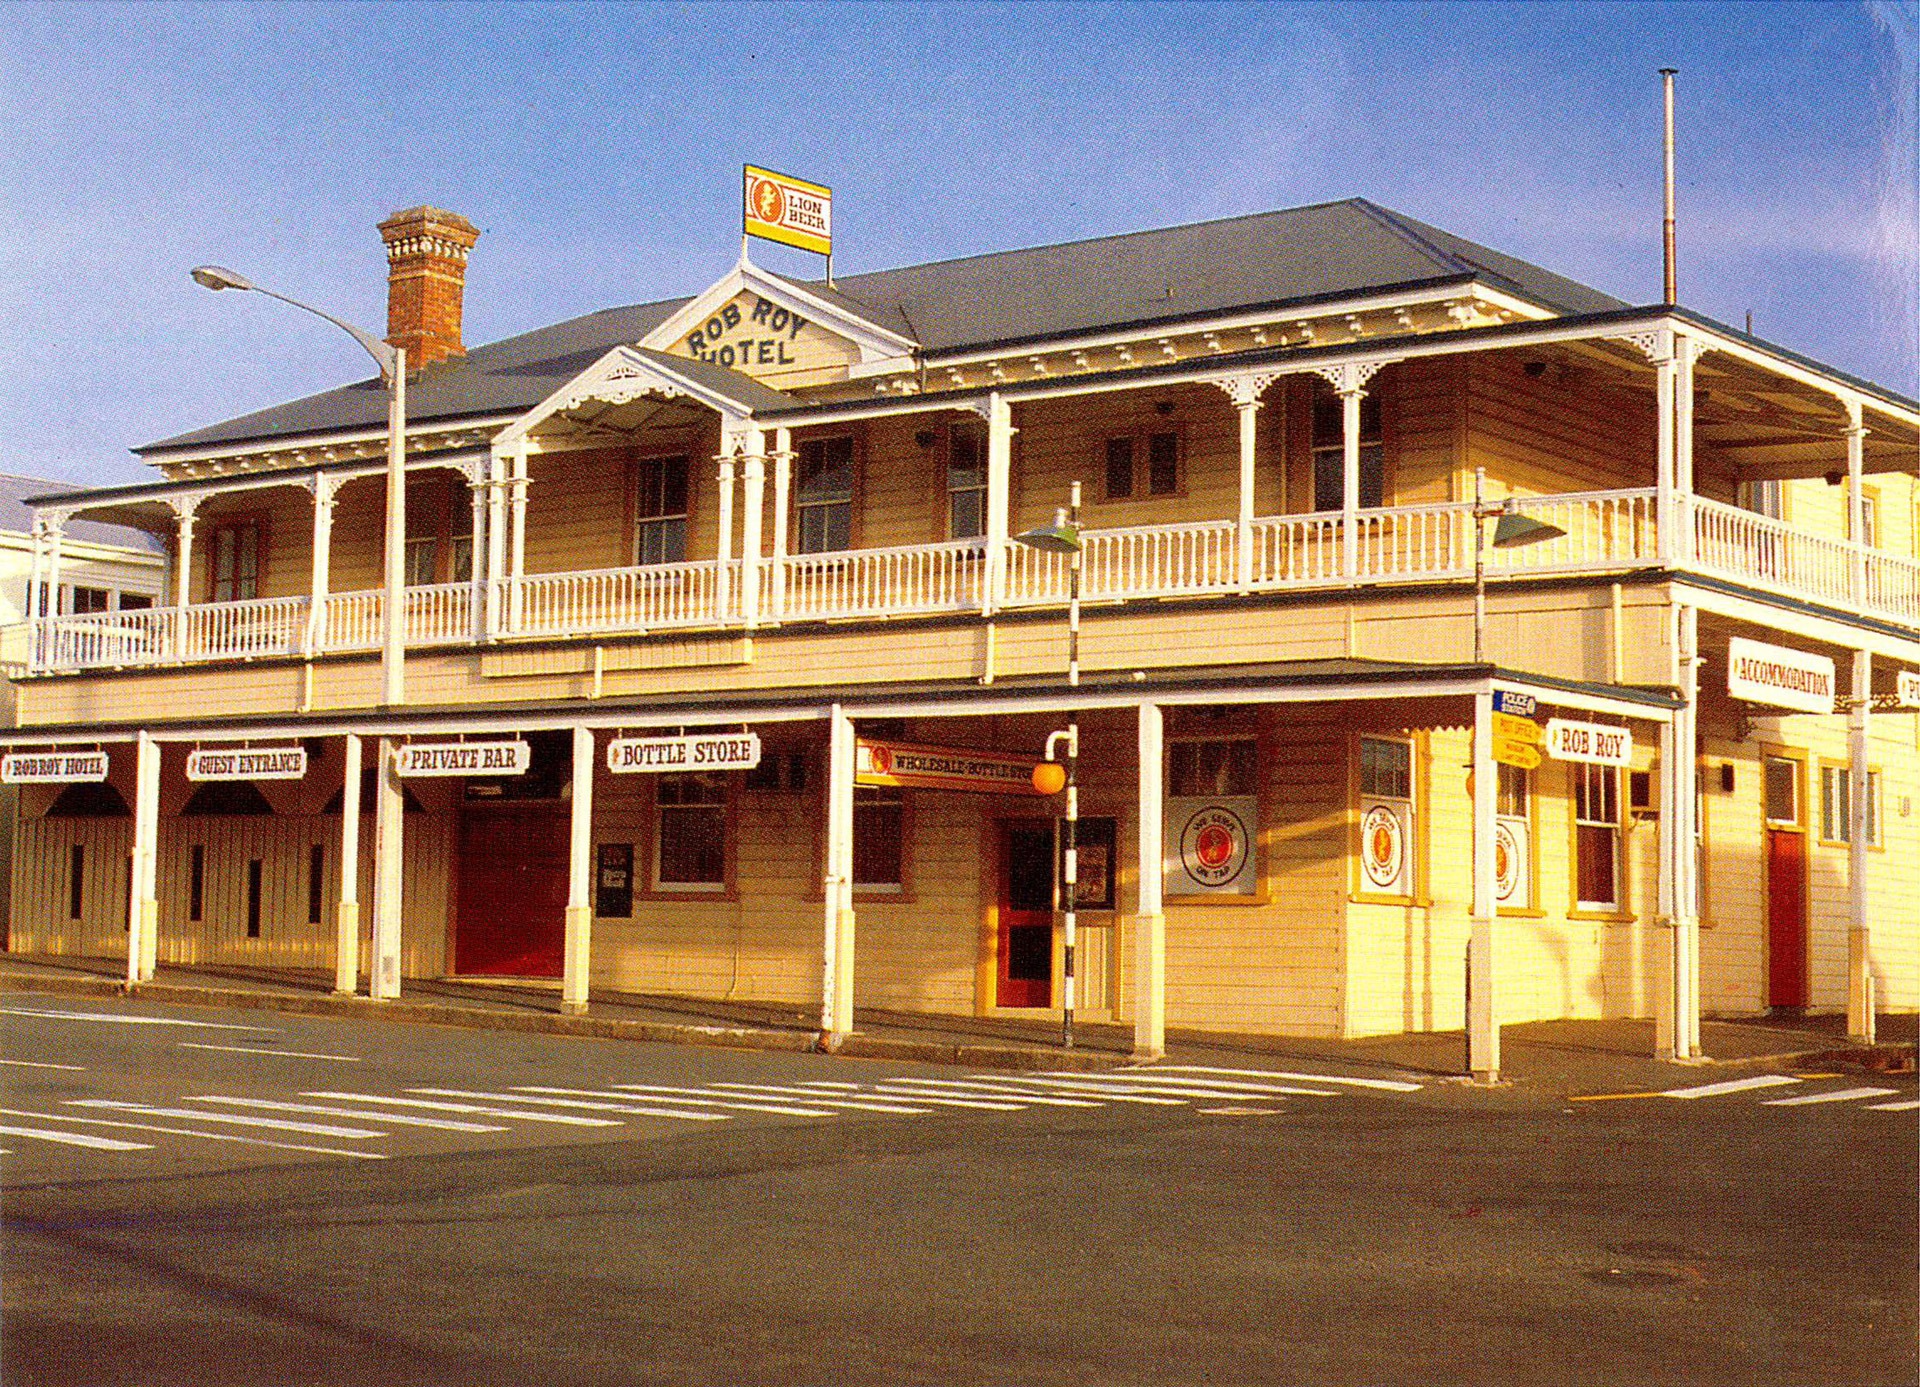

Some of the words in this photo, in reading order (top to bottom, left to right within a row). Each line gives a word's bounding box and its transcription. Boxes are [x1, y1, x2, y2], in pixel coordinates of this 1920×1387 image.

[789, 195, 822, 214] LION
[789, 209, 826, 231] BEER
[688, 302, 741, 356] ROB
[752, 298, 807, 340] ROY
[1739, 657, 1830, 697] ACCOMMODATION
[1502, 691, 1529, 707] POLICE
[622, 743, 687, 766] BOTTLE
[694, 740, 751, 763] STORE
[1562, 727, 1590, 755] ROB
[1595, 732, 1625, 758] ROY
[65, 757, 103, 774] HOTEL
[198, 755, 235, 774] GUEST
[239, 752, 301, 773] ENTRANCE
[410, 749, 479, 769] PRIVATE
[482, 747, 517, 768] BAR
[895, 755, 965, 774] WHOLESALE
